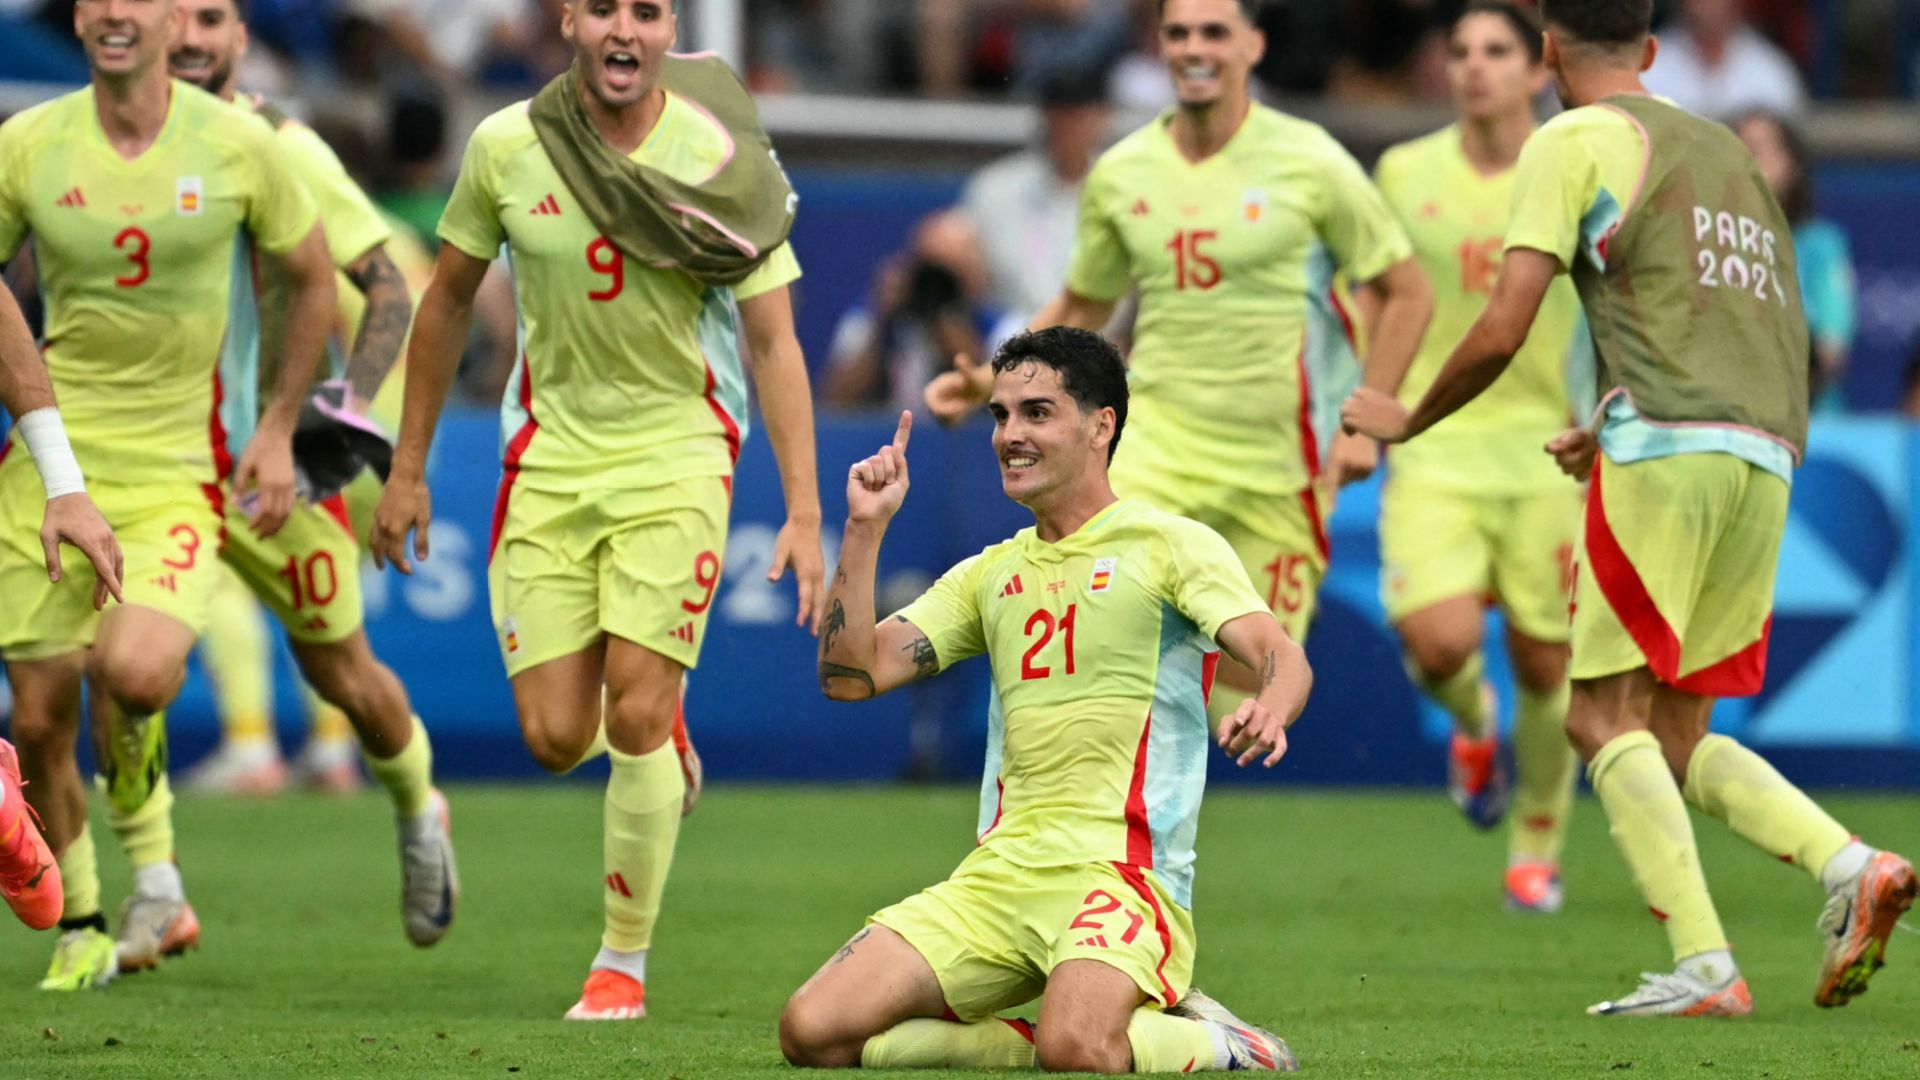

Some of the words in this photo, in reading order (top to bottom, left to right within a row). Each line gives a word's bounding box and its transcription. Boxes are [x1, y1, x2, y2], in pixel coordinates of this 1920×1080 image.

[114, 226, 151, 288] 3
[1165, 229, 1222, 290] 15
[1693, 205, 1776, 266] PARS
[586, 236, 624, 302] 9
[162, 522, 201, 572] 3
[280, 549, 338, 610] 10
[681, 550, 721, 615] 9
[1263, 553, 1305, 614] 15
[1019, 603, 1078, 681] 21
[1069, 888, 1146, 946] 21
